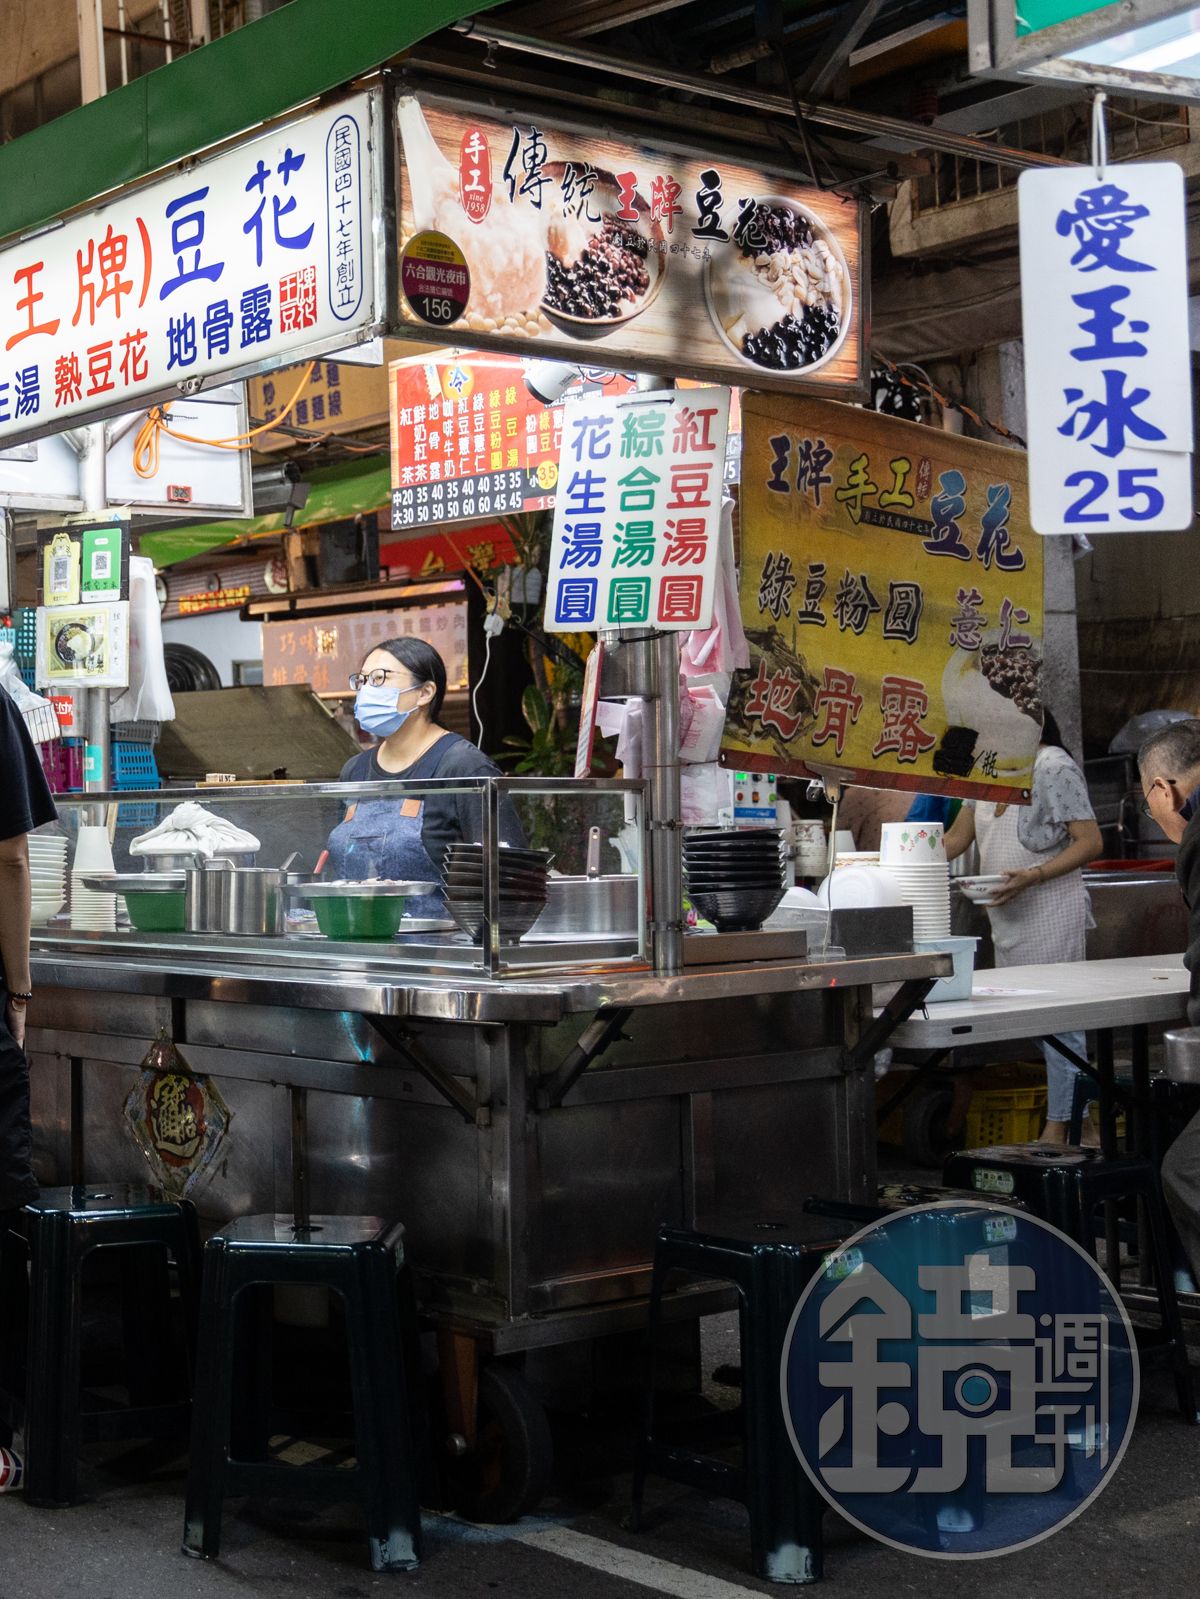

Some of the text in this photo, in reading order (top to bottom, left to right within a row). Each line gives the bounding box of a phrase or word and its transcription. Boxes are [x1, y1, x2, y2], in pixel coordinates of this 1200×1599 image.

[464, 131, 486, 193] 手工
[333, 125, 355, 309] 民國四十七年創立
[466, 200, 486, 213] 1958
[405, 263, 467, 286] 六合觀光夜市
[422, 297, 452, 320] 156
[54, 328, 149, 408] 熱豆花
[166, 282, 273, 372] 地骨露
[1056, 184, 1168, 459] 愛玉冰
[449, 366, 470, 393] 冷
[400, 407, 419, 485] 紅茶
[413, 404, 428, 482] 鮮奶紅茶
[428, 402, 441, 480] 地骨露
[443, 399, 456, 478] 咖啡牛奶
[393, 471, 521, 507] 中 20 35 40 35 40 40 35 35
[393, 491, 522, 525] 大 30 50 50 50 60 60 45 45
[555, 413, 615, 624] 花生湯圓
[606, 409, 665, 624] 綜合湯圓
[657, 406, 718, 623] 紅豆湯圓
[767, 433, 834, 507] 王牌
[834, 454, 916, 525] 手工
[923, 468, 1026, 571] 豆花
[1063, 468, 1165, 523] 25
[758, 551, 1034, 651] 綠豆粉圓 薏仁
[744, 657, 937, 763] 地骨露
